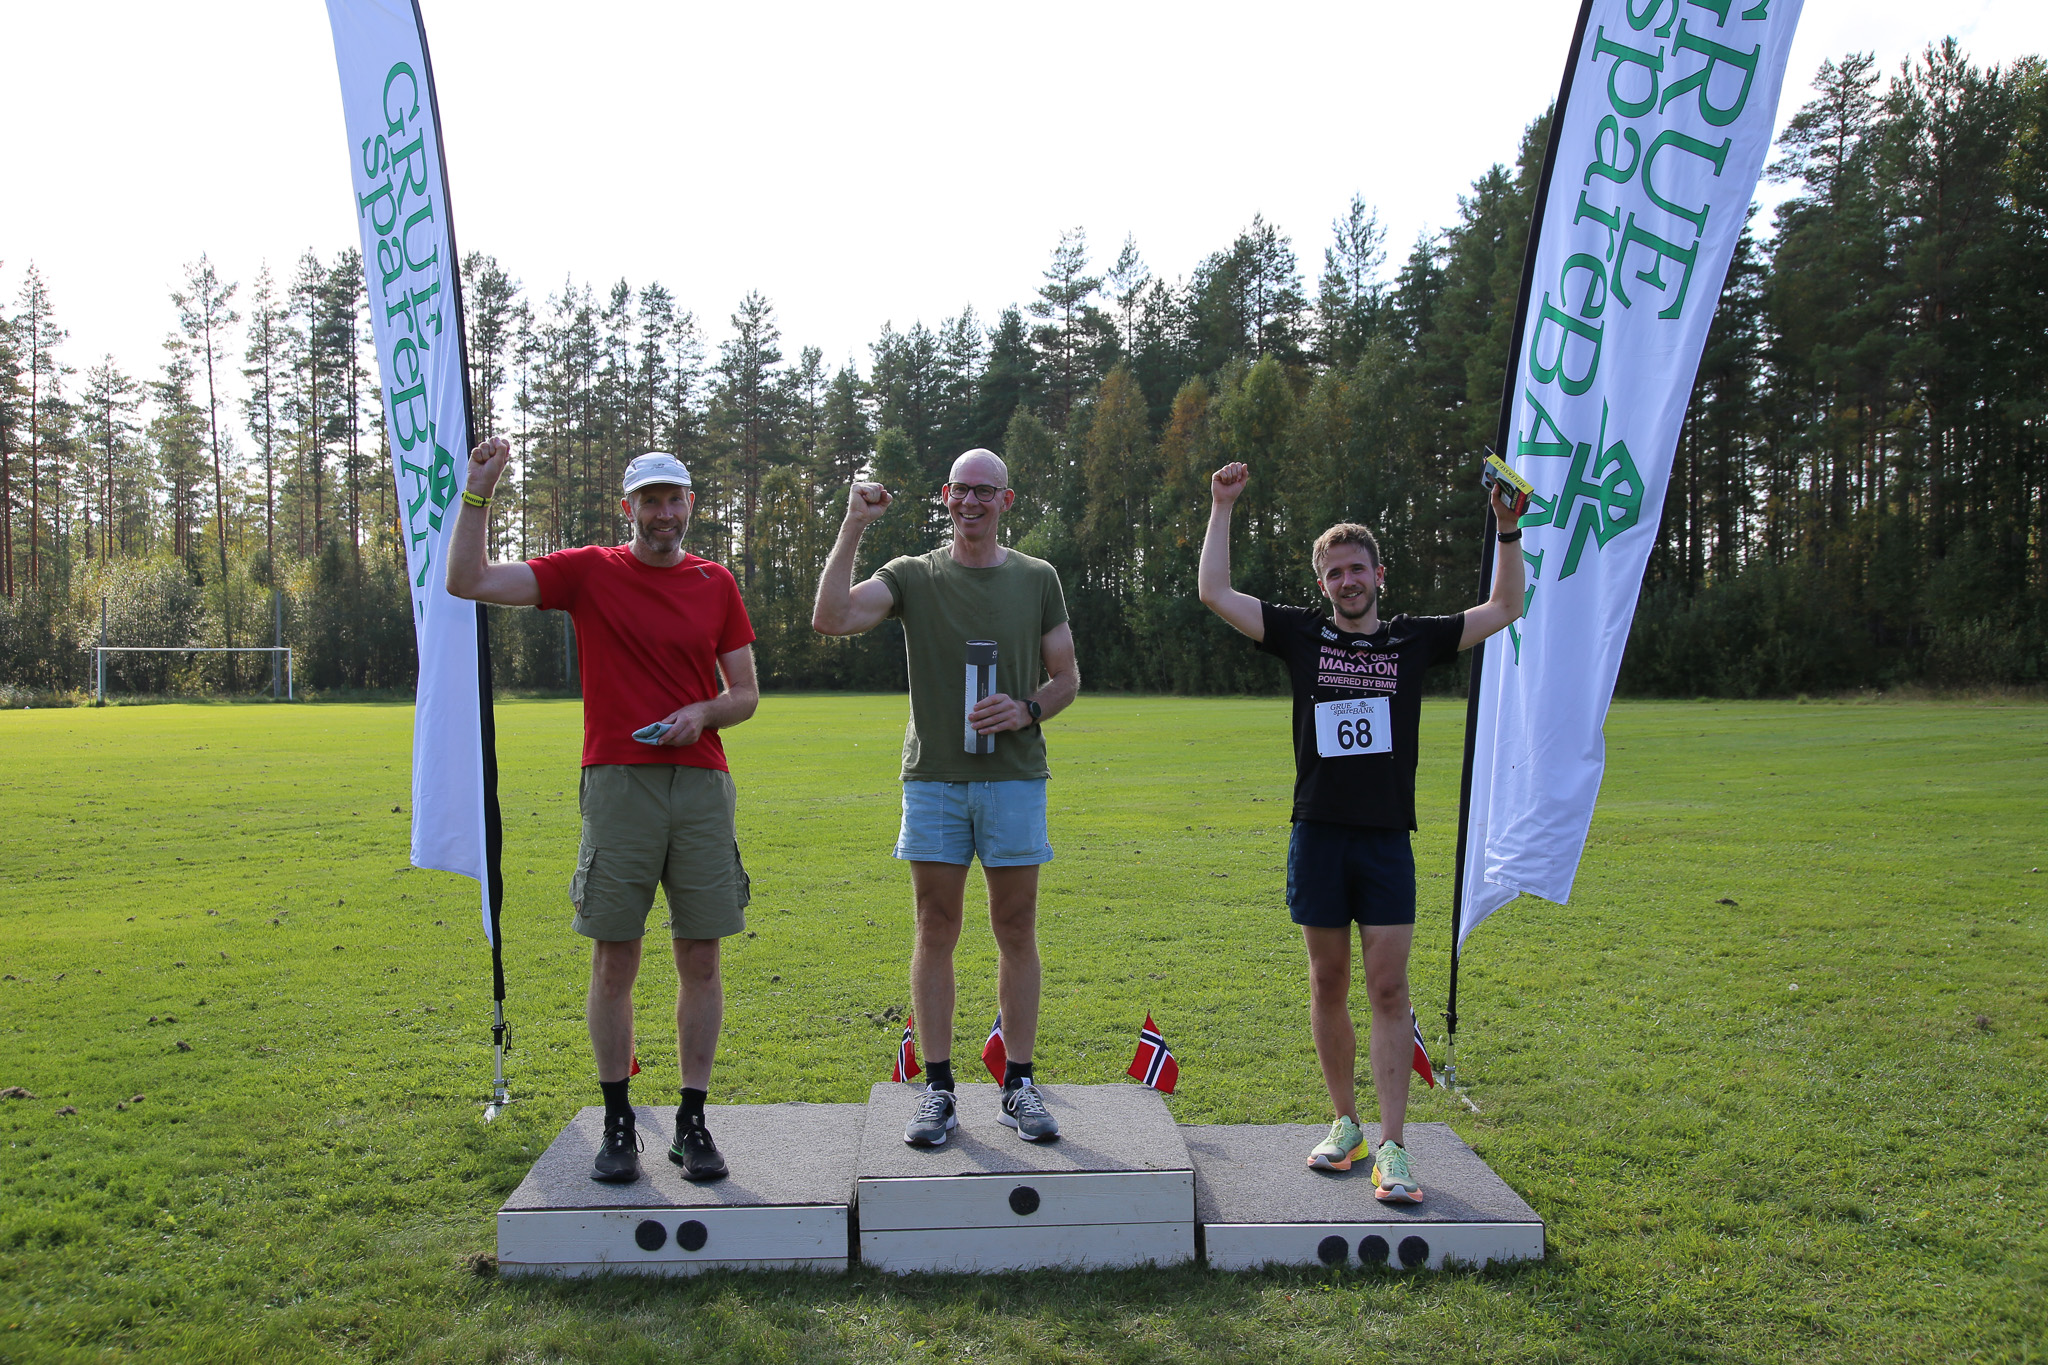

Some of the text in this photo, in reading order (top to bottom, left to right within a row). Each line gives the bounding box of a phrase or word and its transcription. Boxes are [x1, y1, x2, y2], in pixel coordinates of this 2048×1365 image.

[382, 61, 442, 350] GRUE
[1320, 645, 1399, 662] BMW OSLO
[1318, 656, 1398, 676] MARATON
[1317, 675, 1397, 689] POWERED BY BMW
[1330, 702, 1352, 711] GRUE
[1337, 718, 1373, 750] 68
